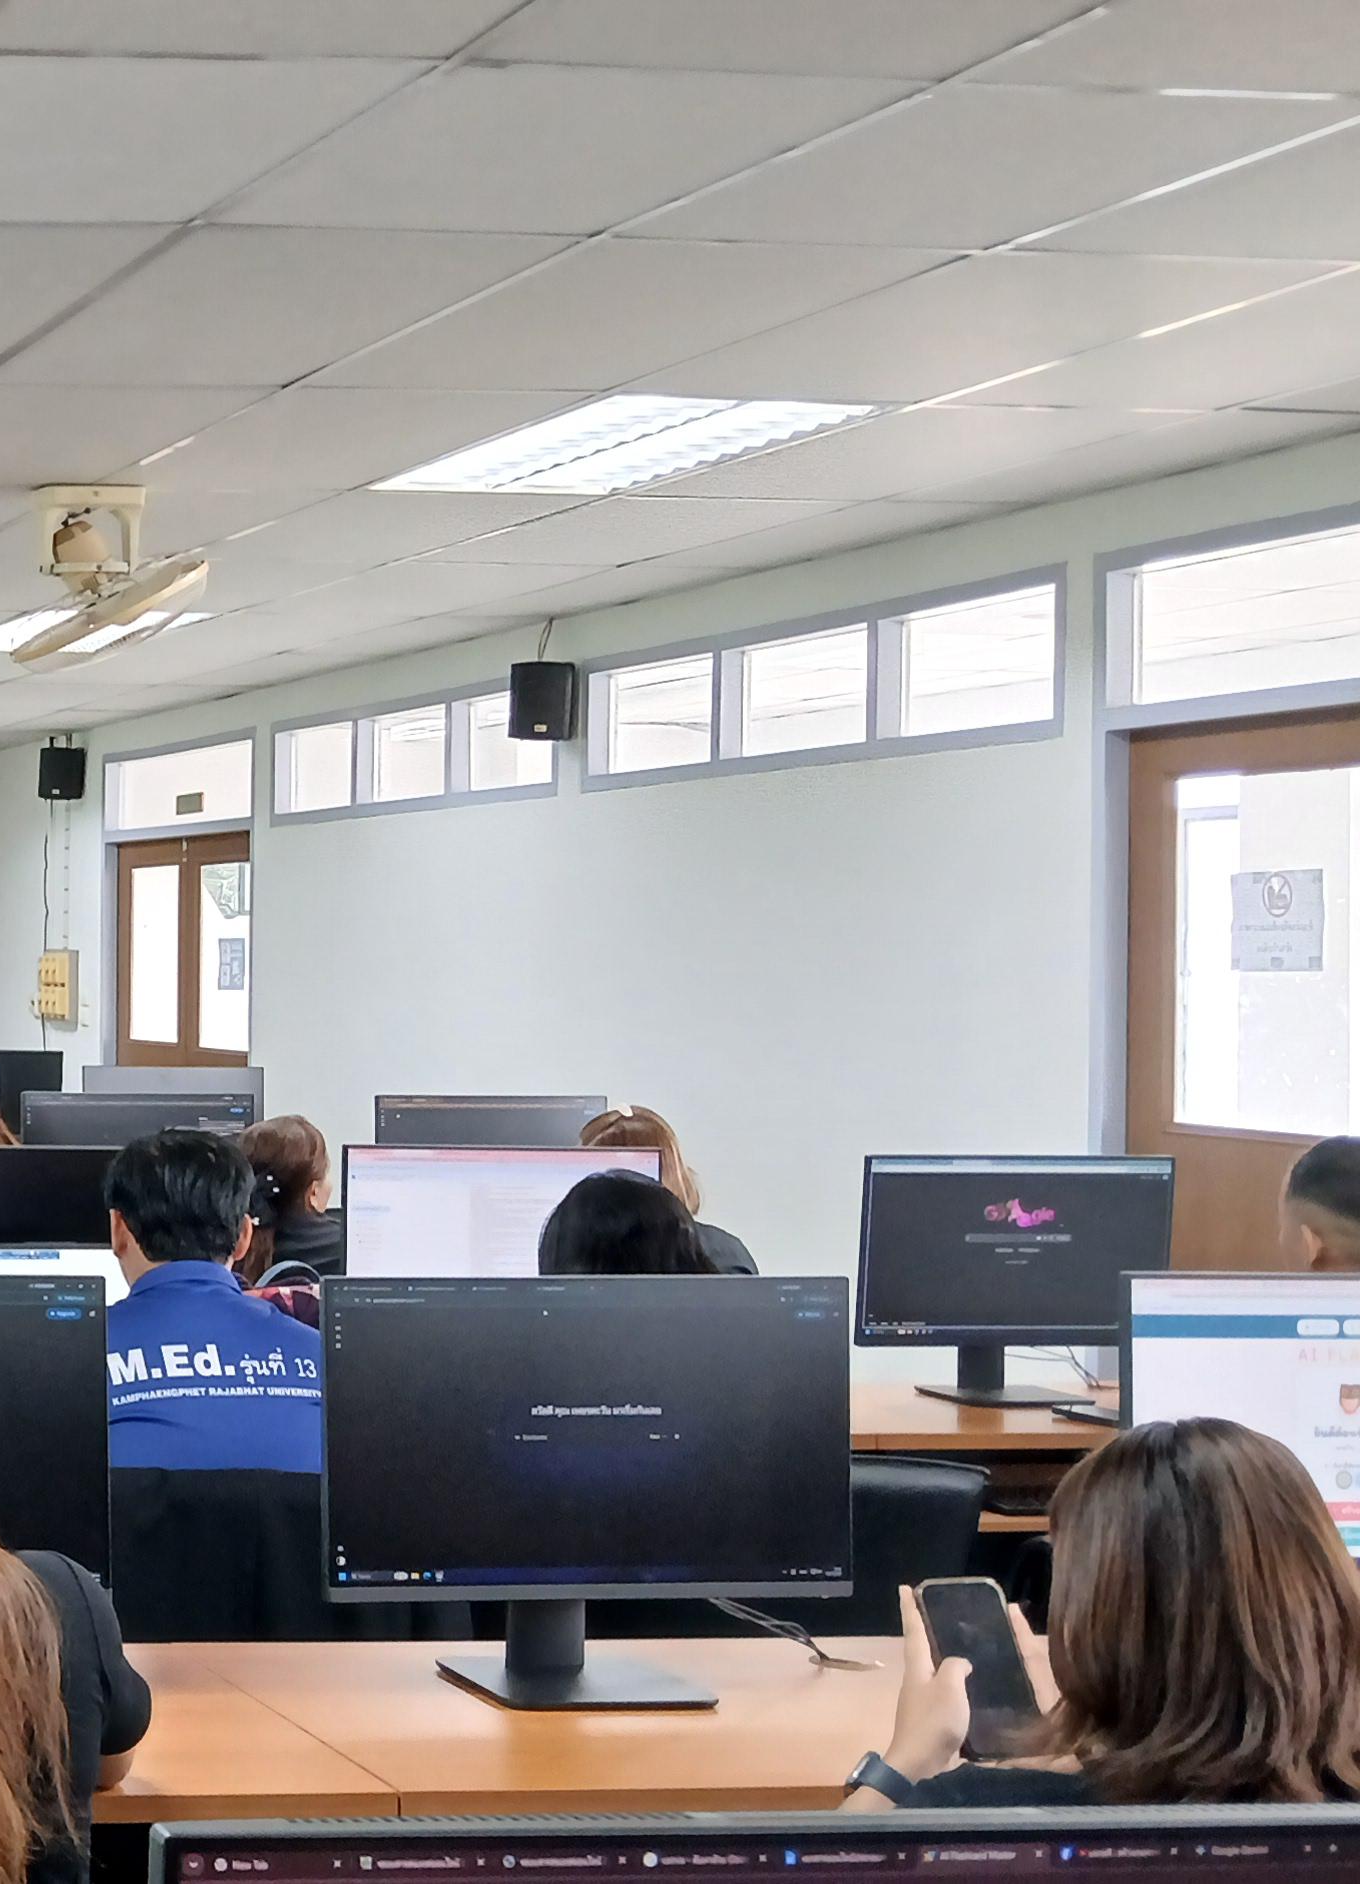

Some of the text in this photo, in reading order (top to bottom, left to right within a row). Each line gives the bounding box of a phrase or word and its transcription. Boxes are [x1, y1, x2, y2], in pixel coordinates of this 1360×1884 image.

[106, 1343, 318, 1386] M.Ed. รุ่นที่ 13
[112, 1386, 206, 1406] KAMPHAENGPHET
[208, 1386, 265, 1397] RAJABHAT
